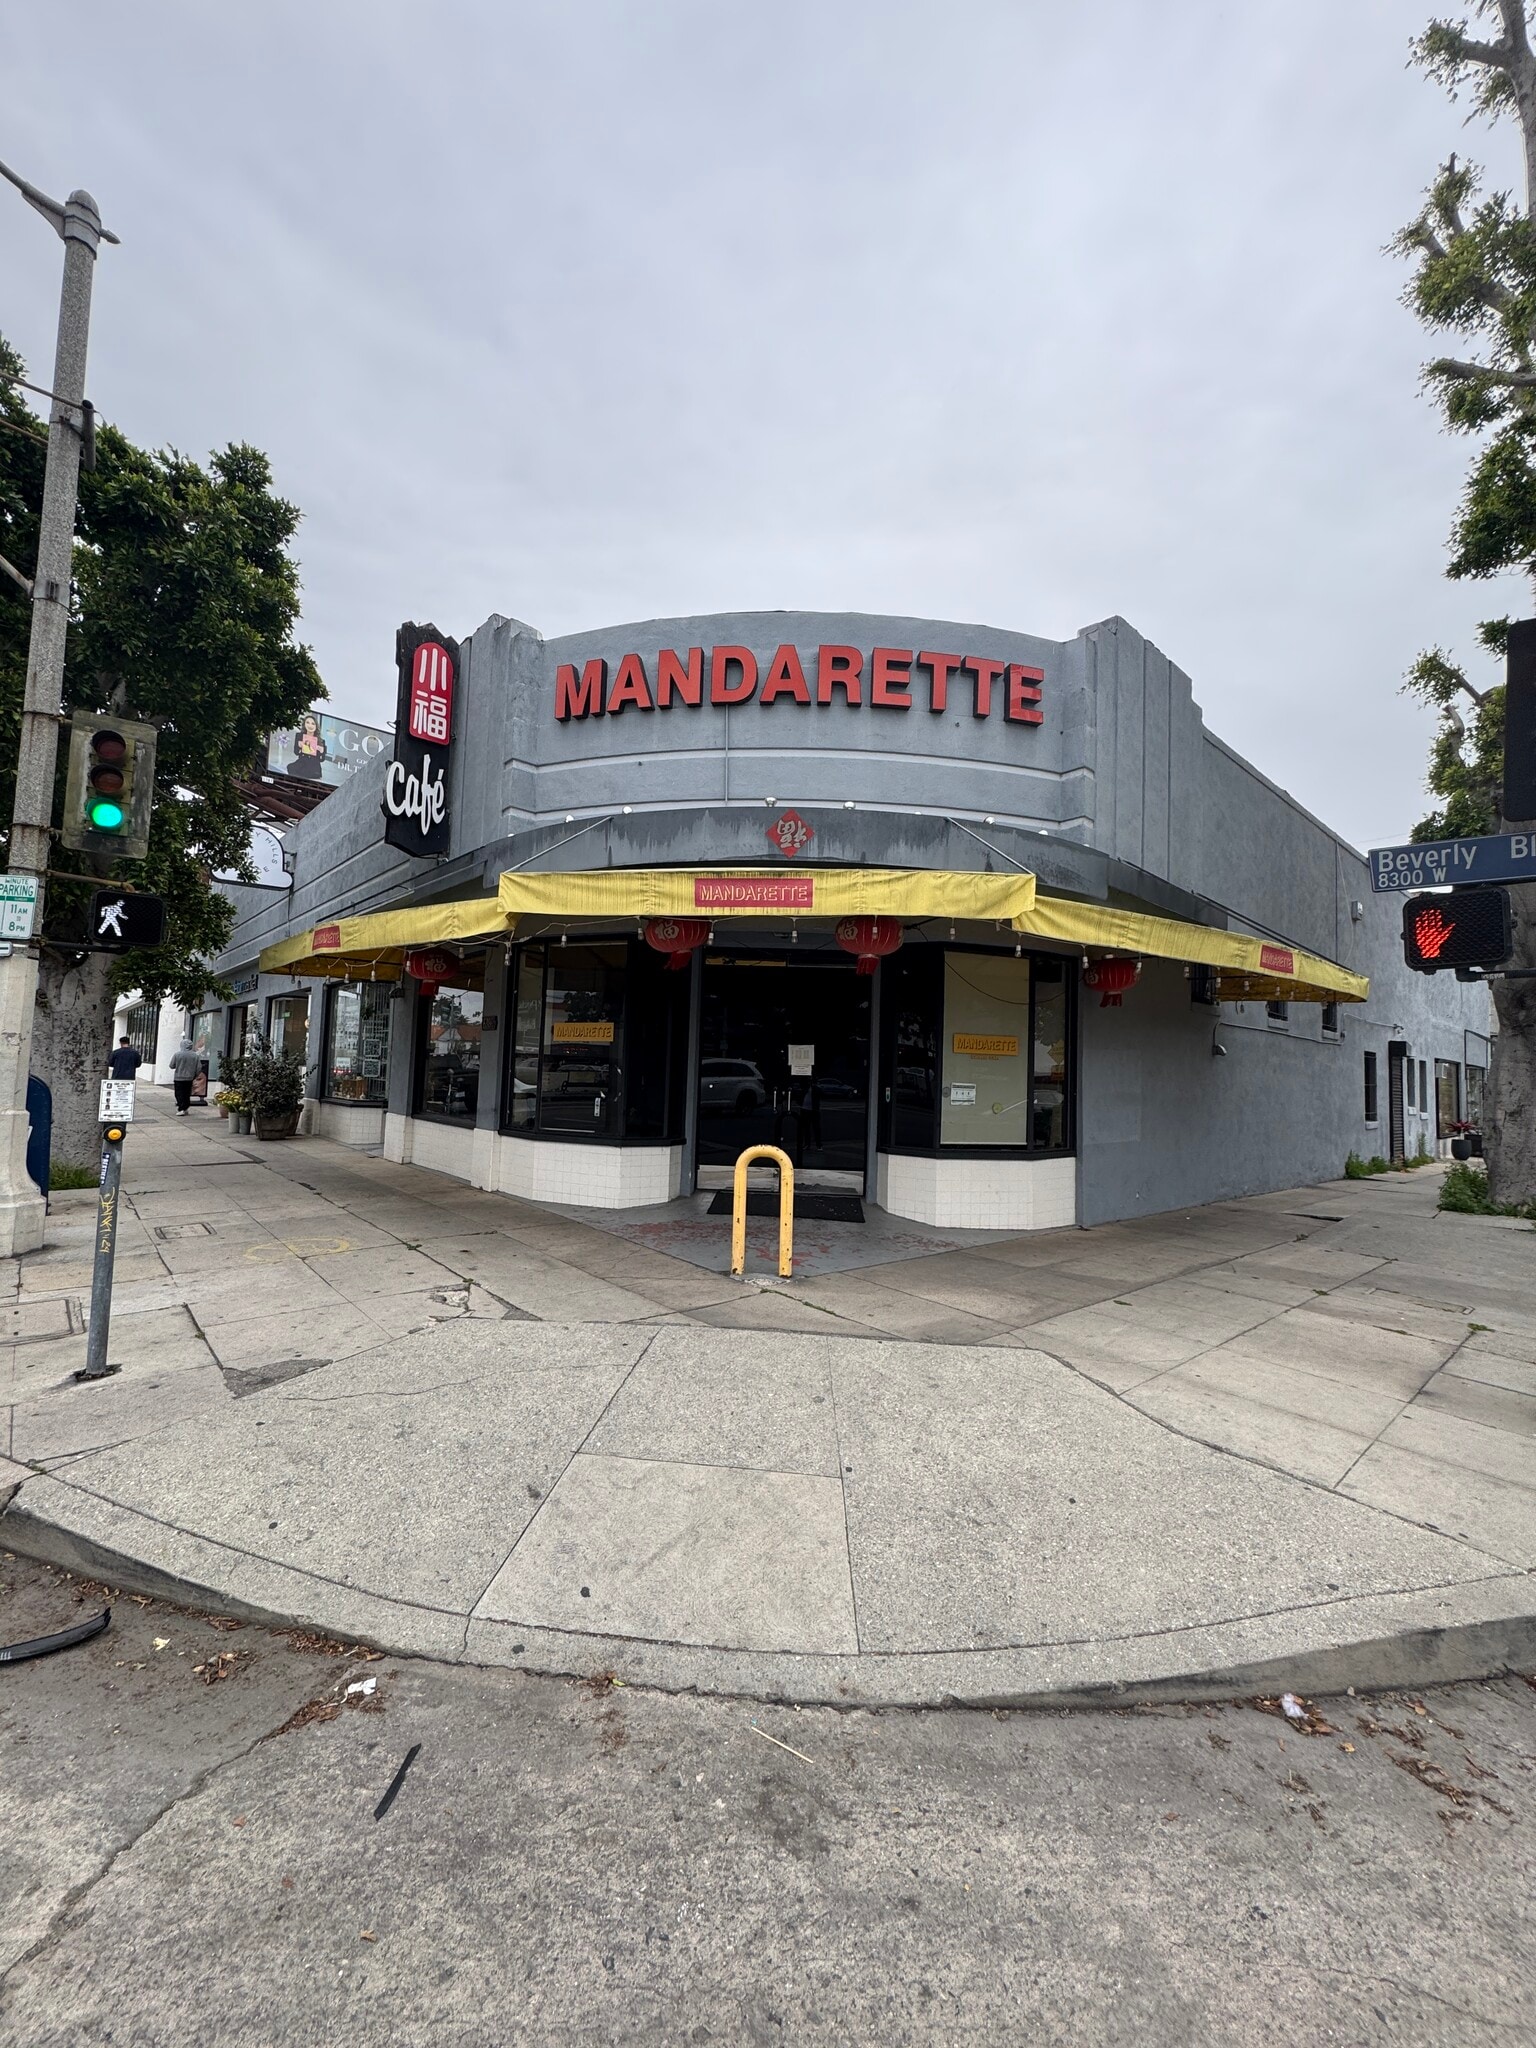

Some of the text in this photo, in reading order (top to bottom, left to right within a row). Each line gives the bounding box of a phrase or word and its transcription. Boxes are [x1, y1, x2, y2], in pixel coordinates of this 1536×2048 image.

[555, 645, 1044, 727] MANDARETTE
[386, 754, 445, 836] Café
[1378, 843, 1478, 873] Beverly
[1378, 867, 1447, 888] 8300 W
[0, 884, 33, 896] PARKING
[700, 885, 808, 901] MANDARETTE
[556, 1026, 612, 1038] MANDARETTE
[956, 1037, 1017, 1051] MANDARETTE
